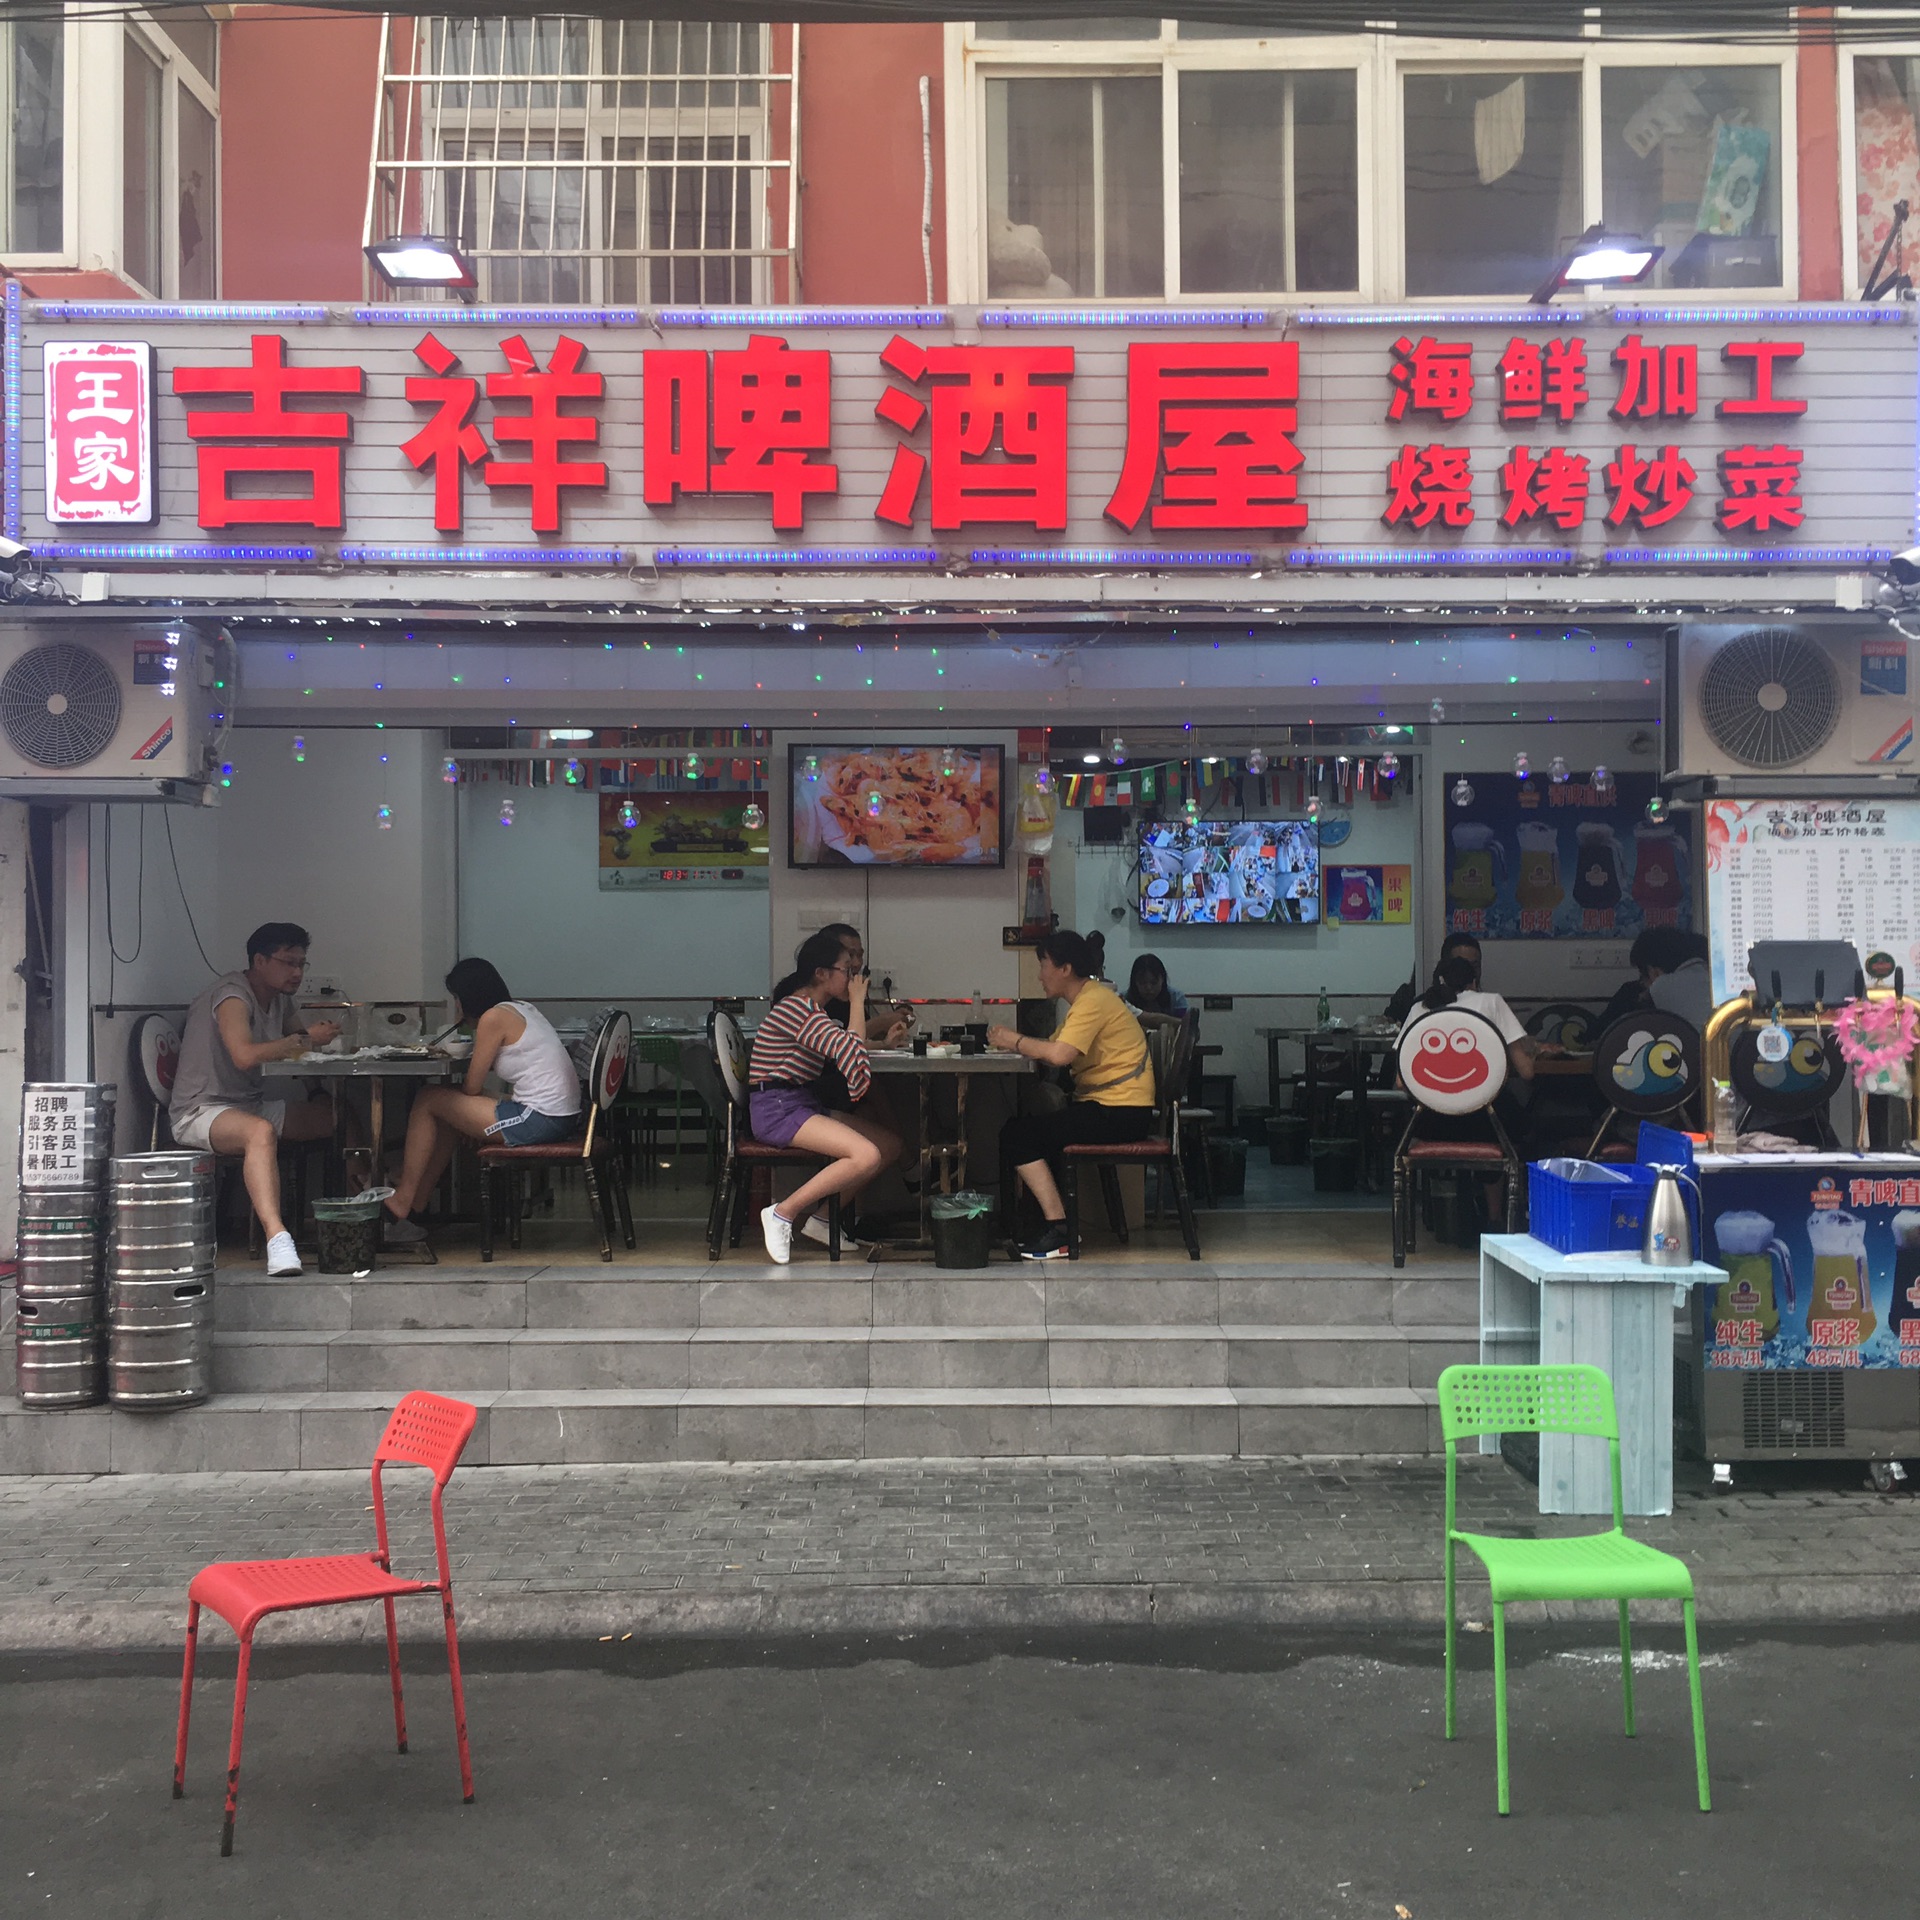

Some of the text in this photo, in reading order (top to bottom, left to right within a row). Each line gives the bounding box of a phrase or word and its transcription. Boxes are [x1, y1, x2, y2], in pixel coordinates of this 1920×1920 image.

[1386, 335, 1808, 423] 海鲜加工
[65, 371, 136, 490] 王家
[172, 332, 1310, 534] 吉祥啤酒屋
[1382, 443, 1806, 531] 烧烤炒菜
[141, 728, 172, 759] Shinco
[1766, 808, 1887, 824] 吉祥啤酒屋
[1453, 908, 1487, 932] 纯生
[34, 1096, 68, 1112] 招聘
[28, 1115, 77, 1131] 服务员
[28, 1134, 77, 1150] 引客员
[27, 1154, 77, 1170] 暑假工
[1849, 1178, 1920, 1207] 青啤直
[1715, 1319, 1764, 1347] 纯生
[1811, 1318, 1860, 1346] 原浆
